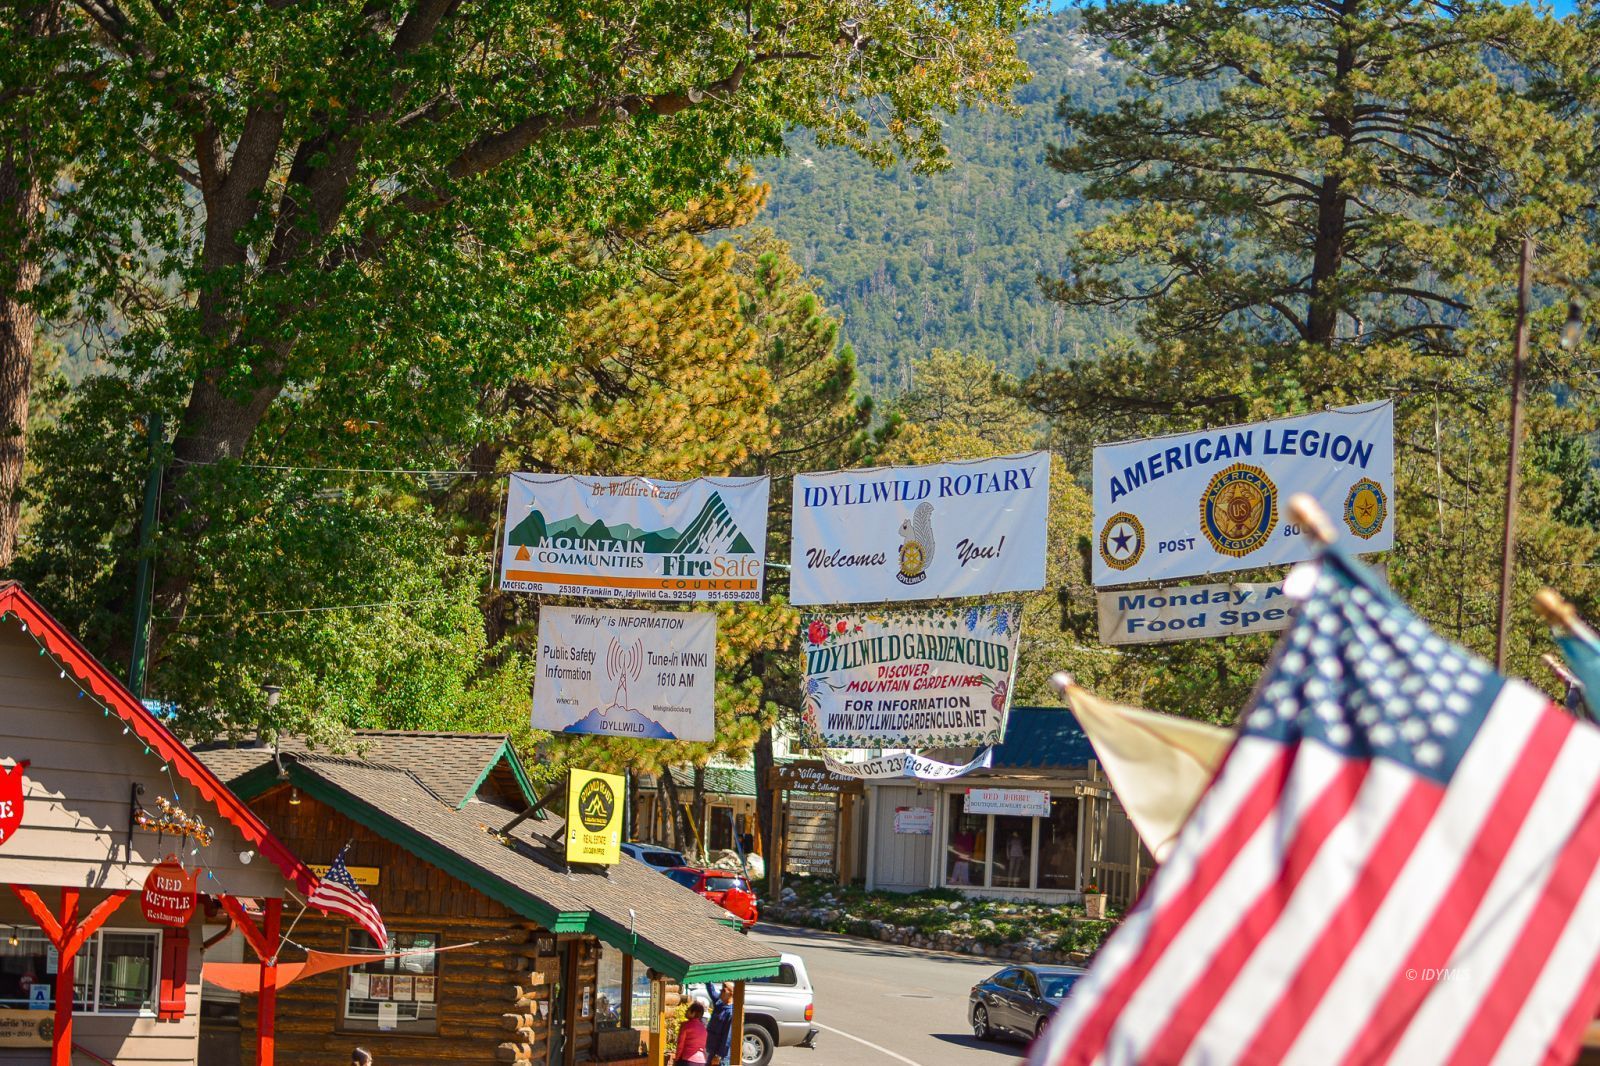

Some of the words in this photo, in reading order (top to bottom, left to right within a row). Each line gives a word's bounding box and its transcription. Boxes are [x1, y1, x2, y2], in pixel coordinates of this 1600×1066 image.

[1110, 431, 1253, 504] AMERICAN
[1263, 429, 1374, 469] LEGION
[609, 481, 648, 496] Wildfire
[803, 479, 932, 508] IDYLLWILD
[938, 466, 1037, 498] ROTARY
[1208, 472, 1270, 504] AMERICAN
[539, 535, 646, 553] MOUNTAIN
[1158, 538, 1195, 553] POST
[1218, 529, 1263, 549] LEGION
[538, 551, 644, 568] COMMUNITIES
[805, 547, 887, 569] Welcomes
[956, 535, 1005, 567] You!
[559, 585, 580, 594] 25380
[582, 587, 612, 596] Franklin
[658, 590, 671, 598] Ca.
[673, 591, 697, 599] 92549
[661, 580, 757, 589] COUNCIL
[708, 591, 760, 600] 951-659-6208
[1119, 589, 1253, 611] Monday
[570, 614, 606, 628] "Winky"
[607, 616, 616, 627] is
[618, 617, 684, 629] INFORMATION
[1127, 612, 1206, 634] Food
[543, 645, 568, 660] Public
[570, 647, 596, 665] Safety
[681, 653, 708, 668] WNKI
[806, 634, 901, 676] IDYLLWILD
[545, 664, 592, 681] Information
[878, 663, 930, 679] DISCOVER
[656, 672, 676, 687] 1610
[678, 673, 694, 688] AM
[846, 677, 909, 693] MOUNTAIN
[912, 673, 984, 691] GARDENING
[844, 700, 873, 712] FOR
[877, 696, 971, 711] INFORMATION
[599, 720, 645, 733] IDYLLWILD
[827, 709, 987, 731] WWW.IDYLLWILDGARDENCLUB.NET
[863, 761, 887, 775] OCT.
[157, 876, 182, 892] RED
[146, 890, 190, 910] KETTLE
[147, 909, 185, 924] Restaurant
